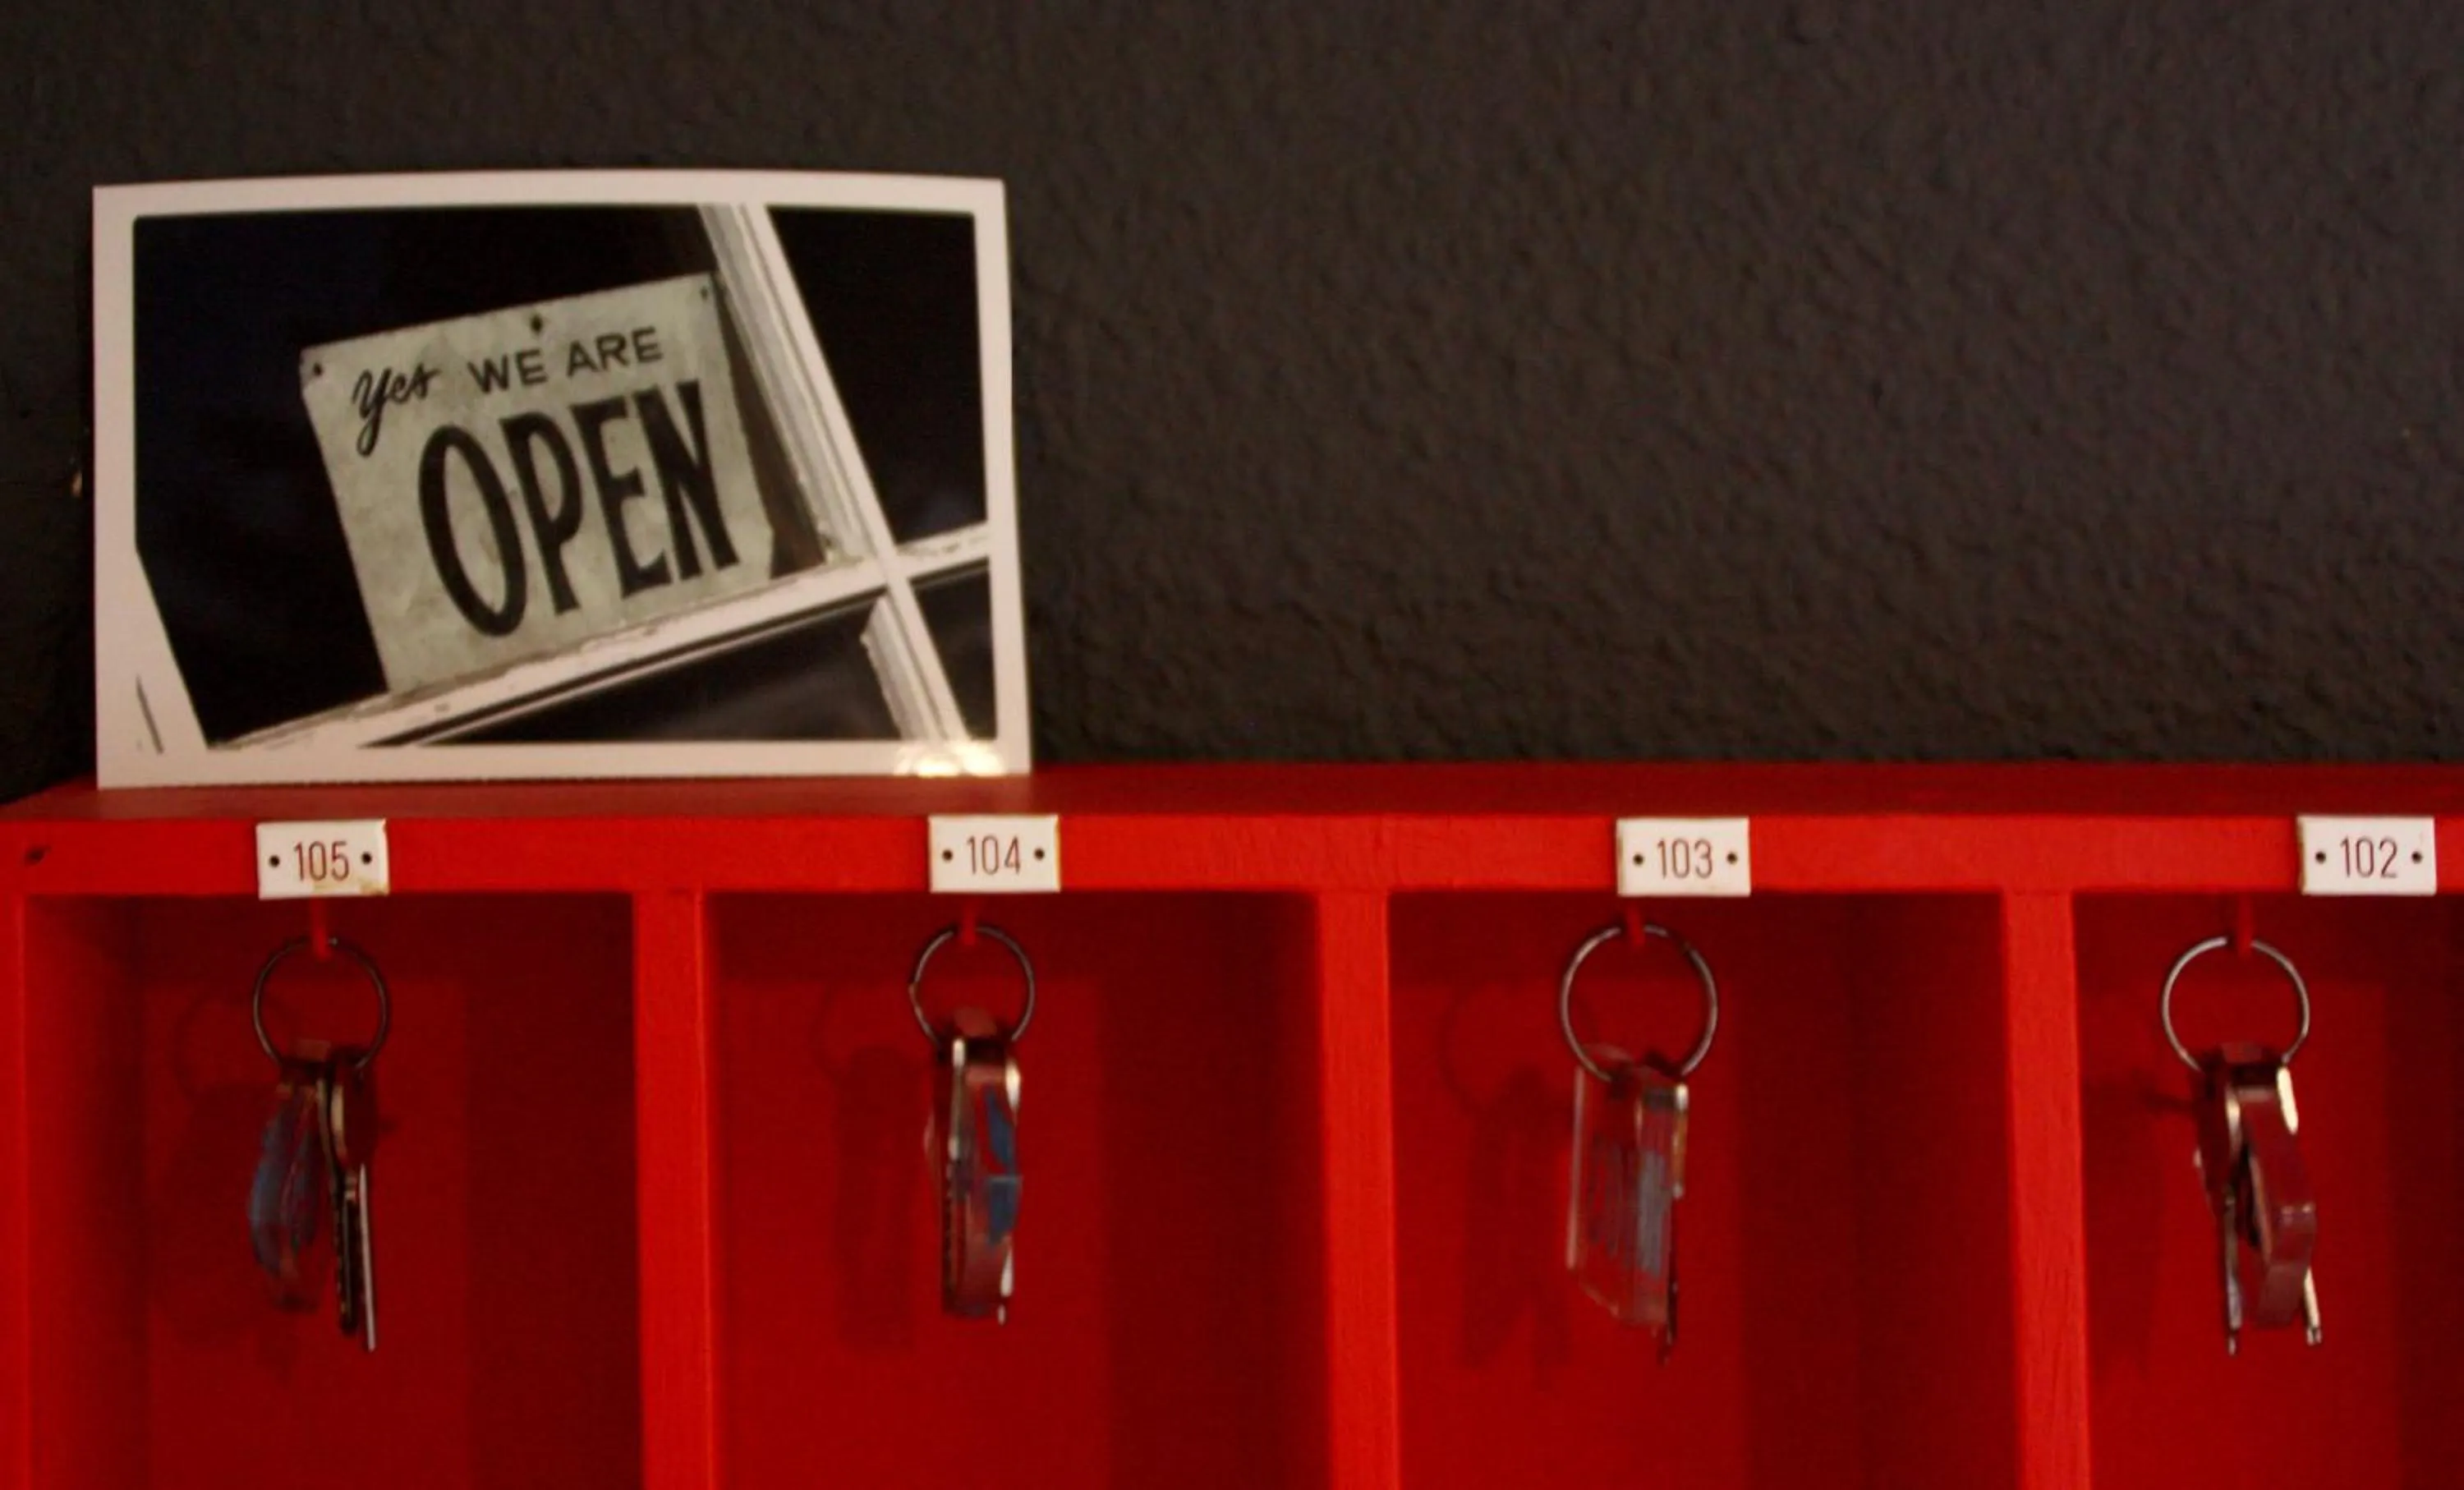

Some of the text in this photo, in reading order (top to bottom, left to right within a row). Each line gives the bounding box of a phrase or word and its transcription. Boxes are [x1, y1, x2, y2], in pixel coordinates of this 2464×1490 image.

[352, 326, 663, 458] Yes WE ARE
[418, 379, 742, 637] OPEN
[293, 840, 350, 881] 105
[966, 836, 1022, 875] 104
[1657, 839, 1713, 879] 103
[2340, 837, 2397, 878] 102
